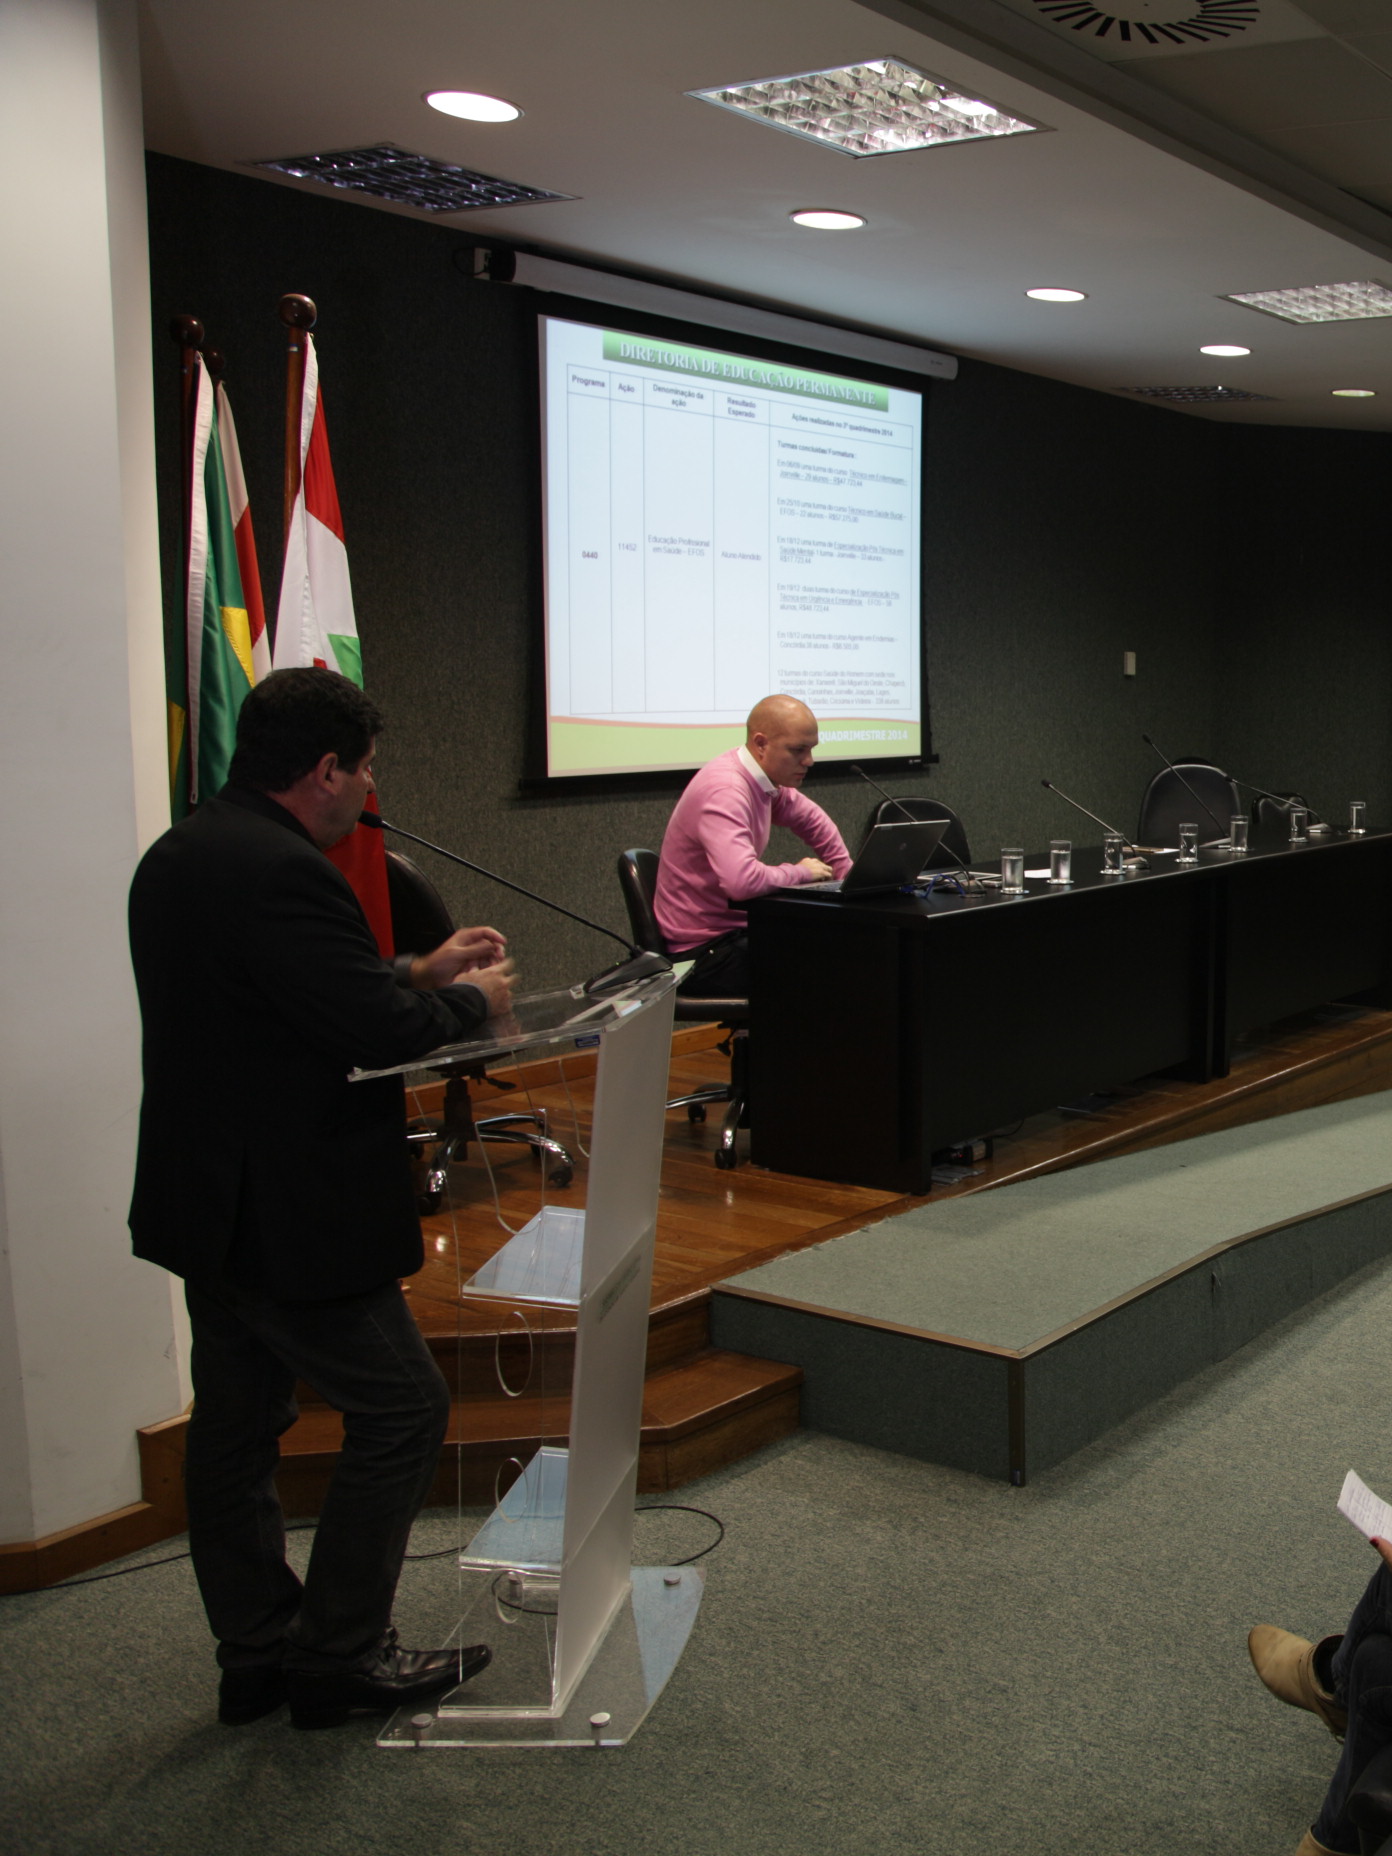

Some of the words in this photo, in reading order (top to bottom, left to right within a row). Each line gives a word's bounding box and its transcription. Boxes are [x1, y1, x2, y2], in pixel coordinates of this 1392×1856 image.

[620, 342, 698, 372] DIRETORIA
[701, 360, 719, 376] DE
[722, 364, 794, 390] EDUCAÇÃO
[795, 375, 877, 406] PERMANENTE
[572, 374, 606, 388] Programa
[618, 383, 635, 393] Ação
[653, 384, 695, 400] Denominação
[671, 399, 686, 408] ação
[727, 396, 757, 409] Resultado
[728, 408, 756, 420] Esperado
[648, 534, 678, 546] Educação
[721, 551, 737, 560] Aluno
[818, 729, 887, 744] QUADRIMESTRE
[888, 729, 908, 740] 2014
